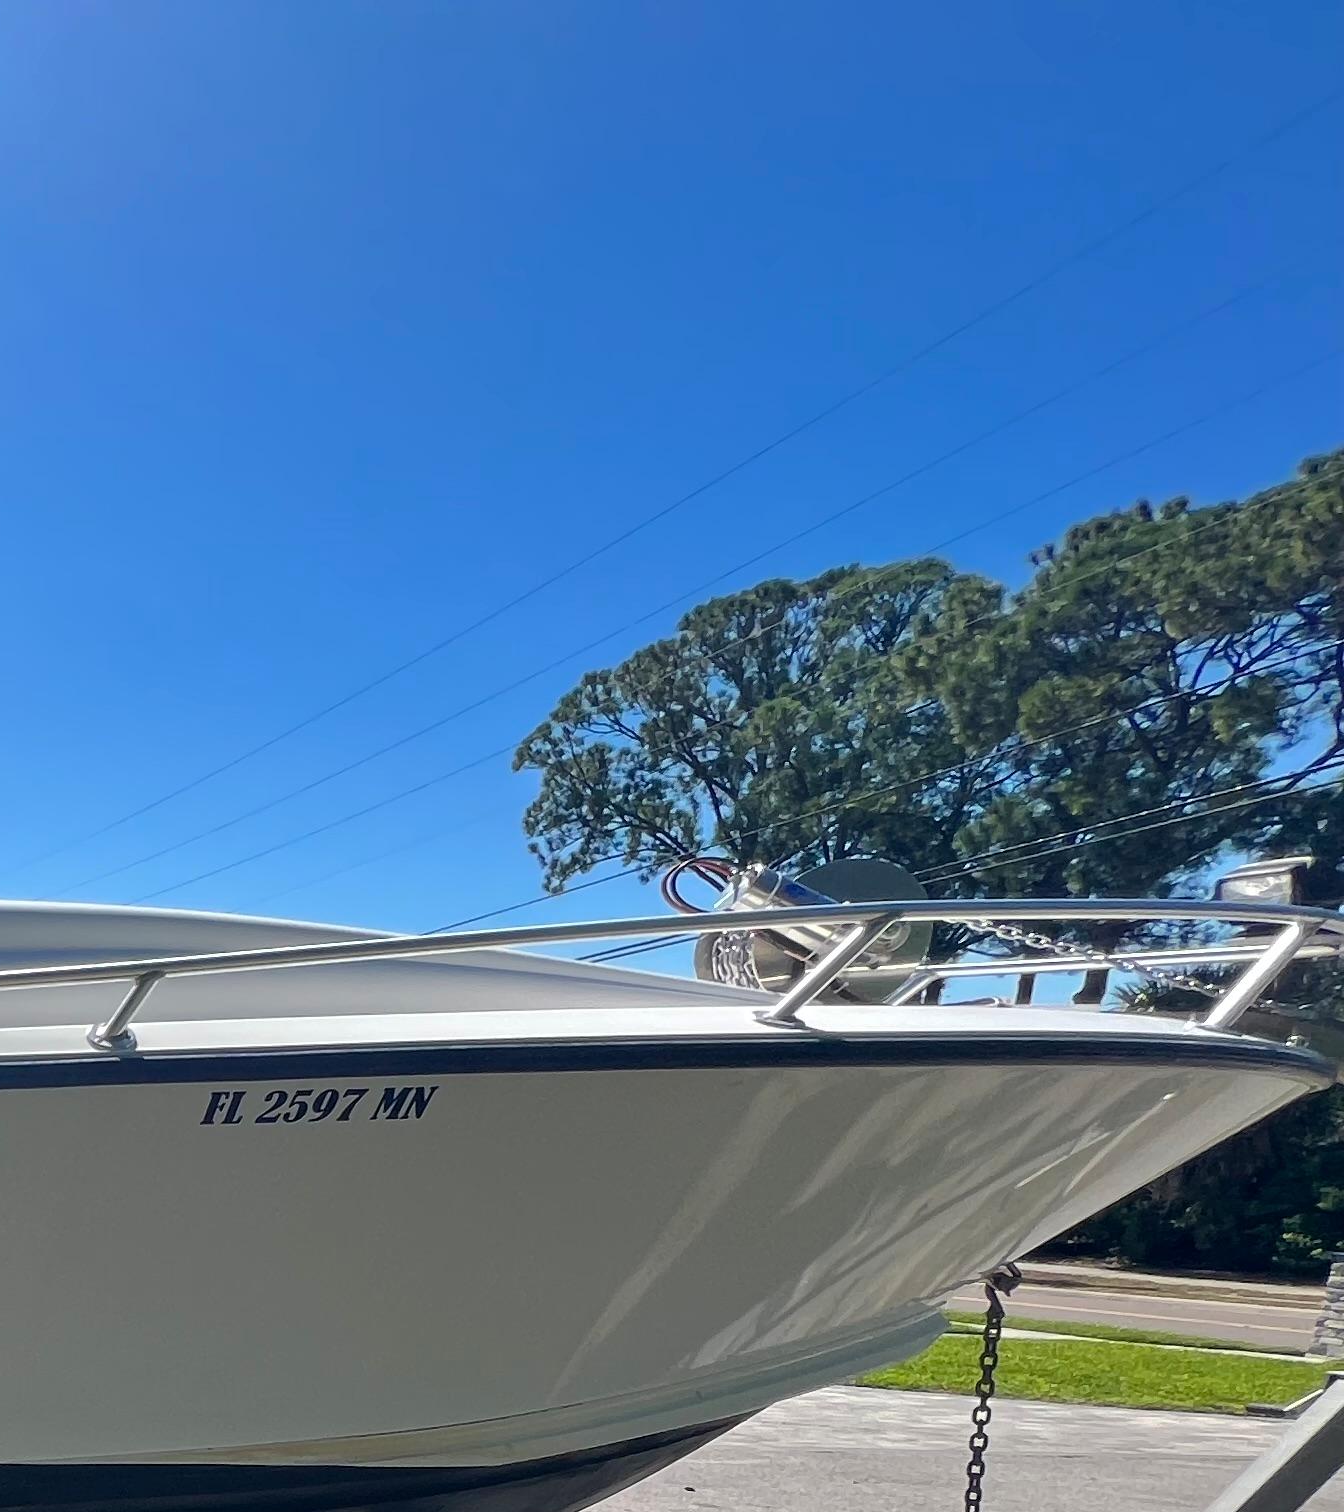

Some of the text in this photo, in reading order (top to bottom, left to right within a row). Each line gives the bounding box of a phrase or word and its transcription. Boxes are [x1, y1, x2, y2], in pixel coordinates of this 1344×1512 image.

[200, 1085, 440, 1125] FL 2597 MN
